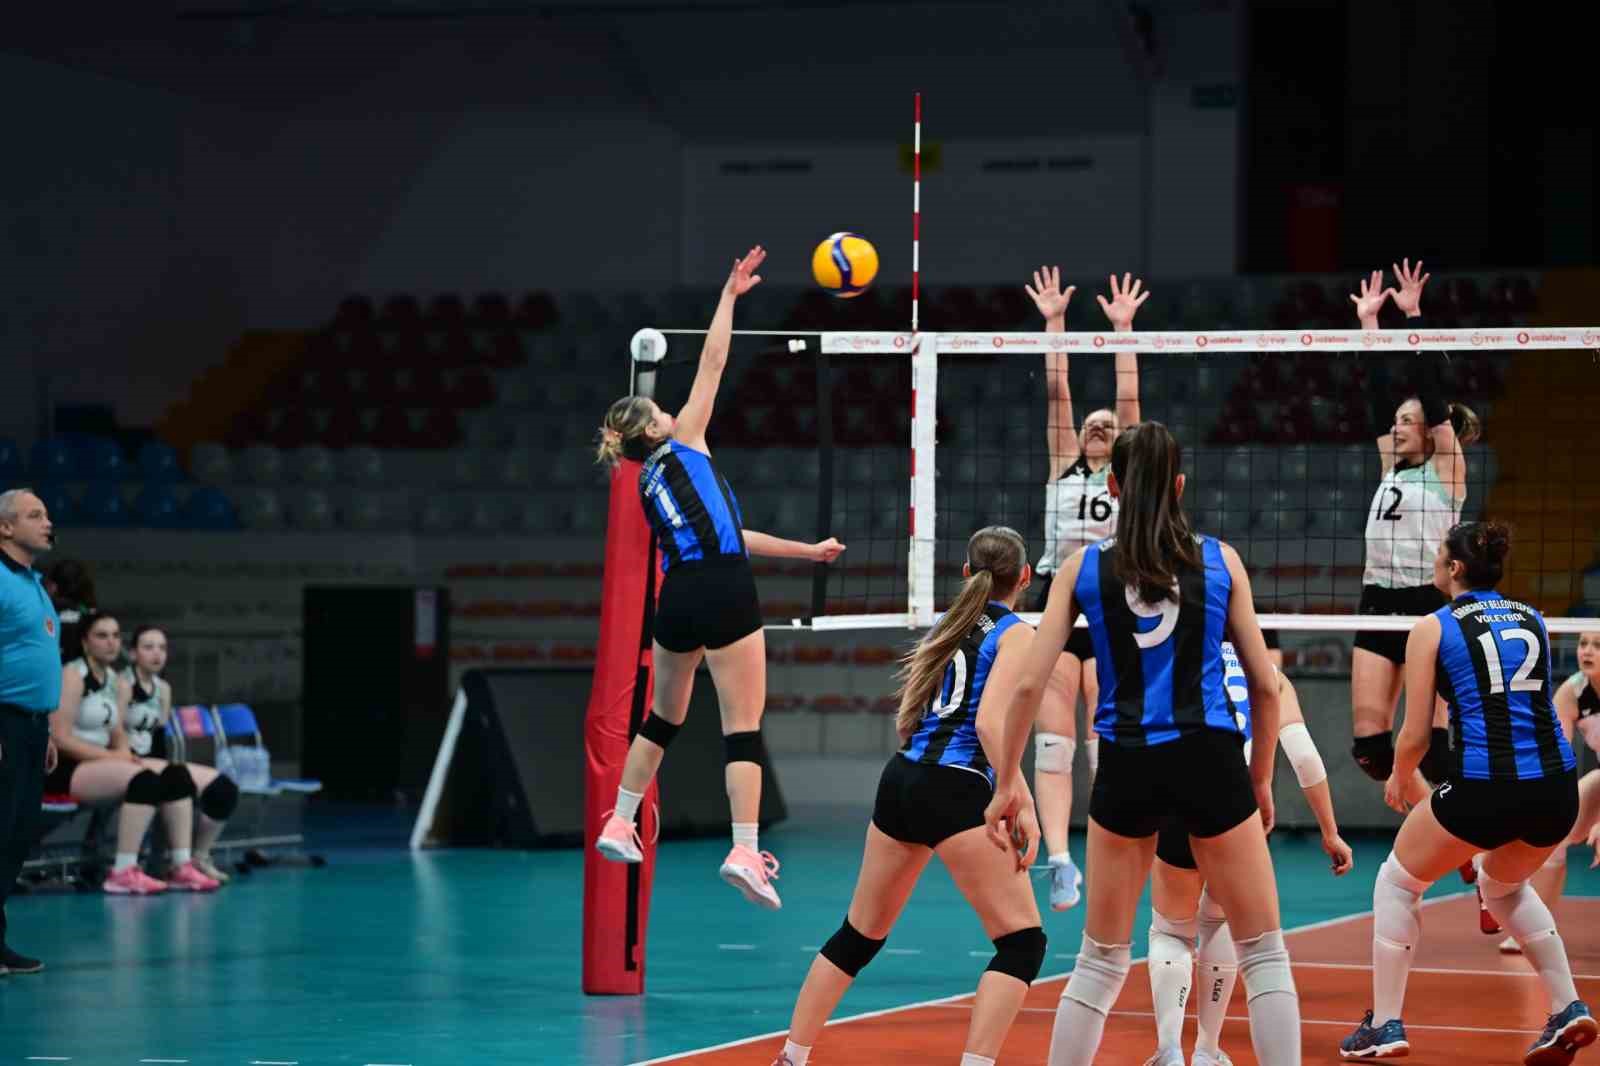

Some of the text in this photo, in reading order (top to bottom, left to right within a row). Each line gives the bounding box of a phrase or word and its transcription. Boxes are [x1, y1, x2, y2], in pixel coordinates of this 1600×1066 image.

[1421, 335, 1456, 343] vodafone
[1531, 334, 1567, 342] vodafone
[1078, 491, 1111, 521] 16
[1376, 486, 1402, 520] 12
[1125, 573, 1181, 648] 9
[1474, 613, 1527, 624] VOLEYBOL
[1477, 628, 1544, 695] 12
